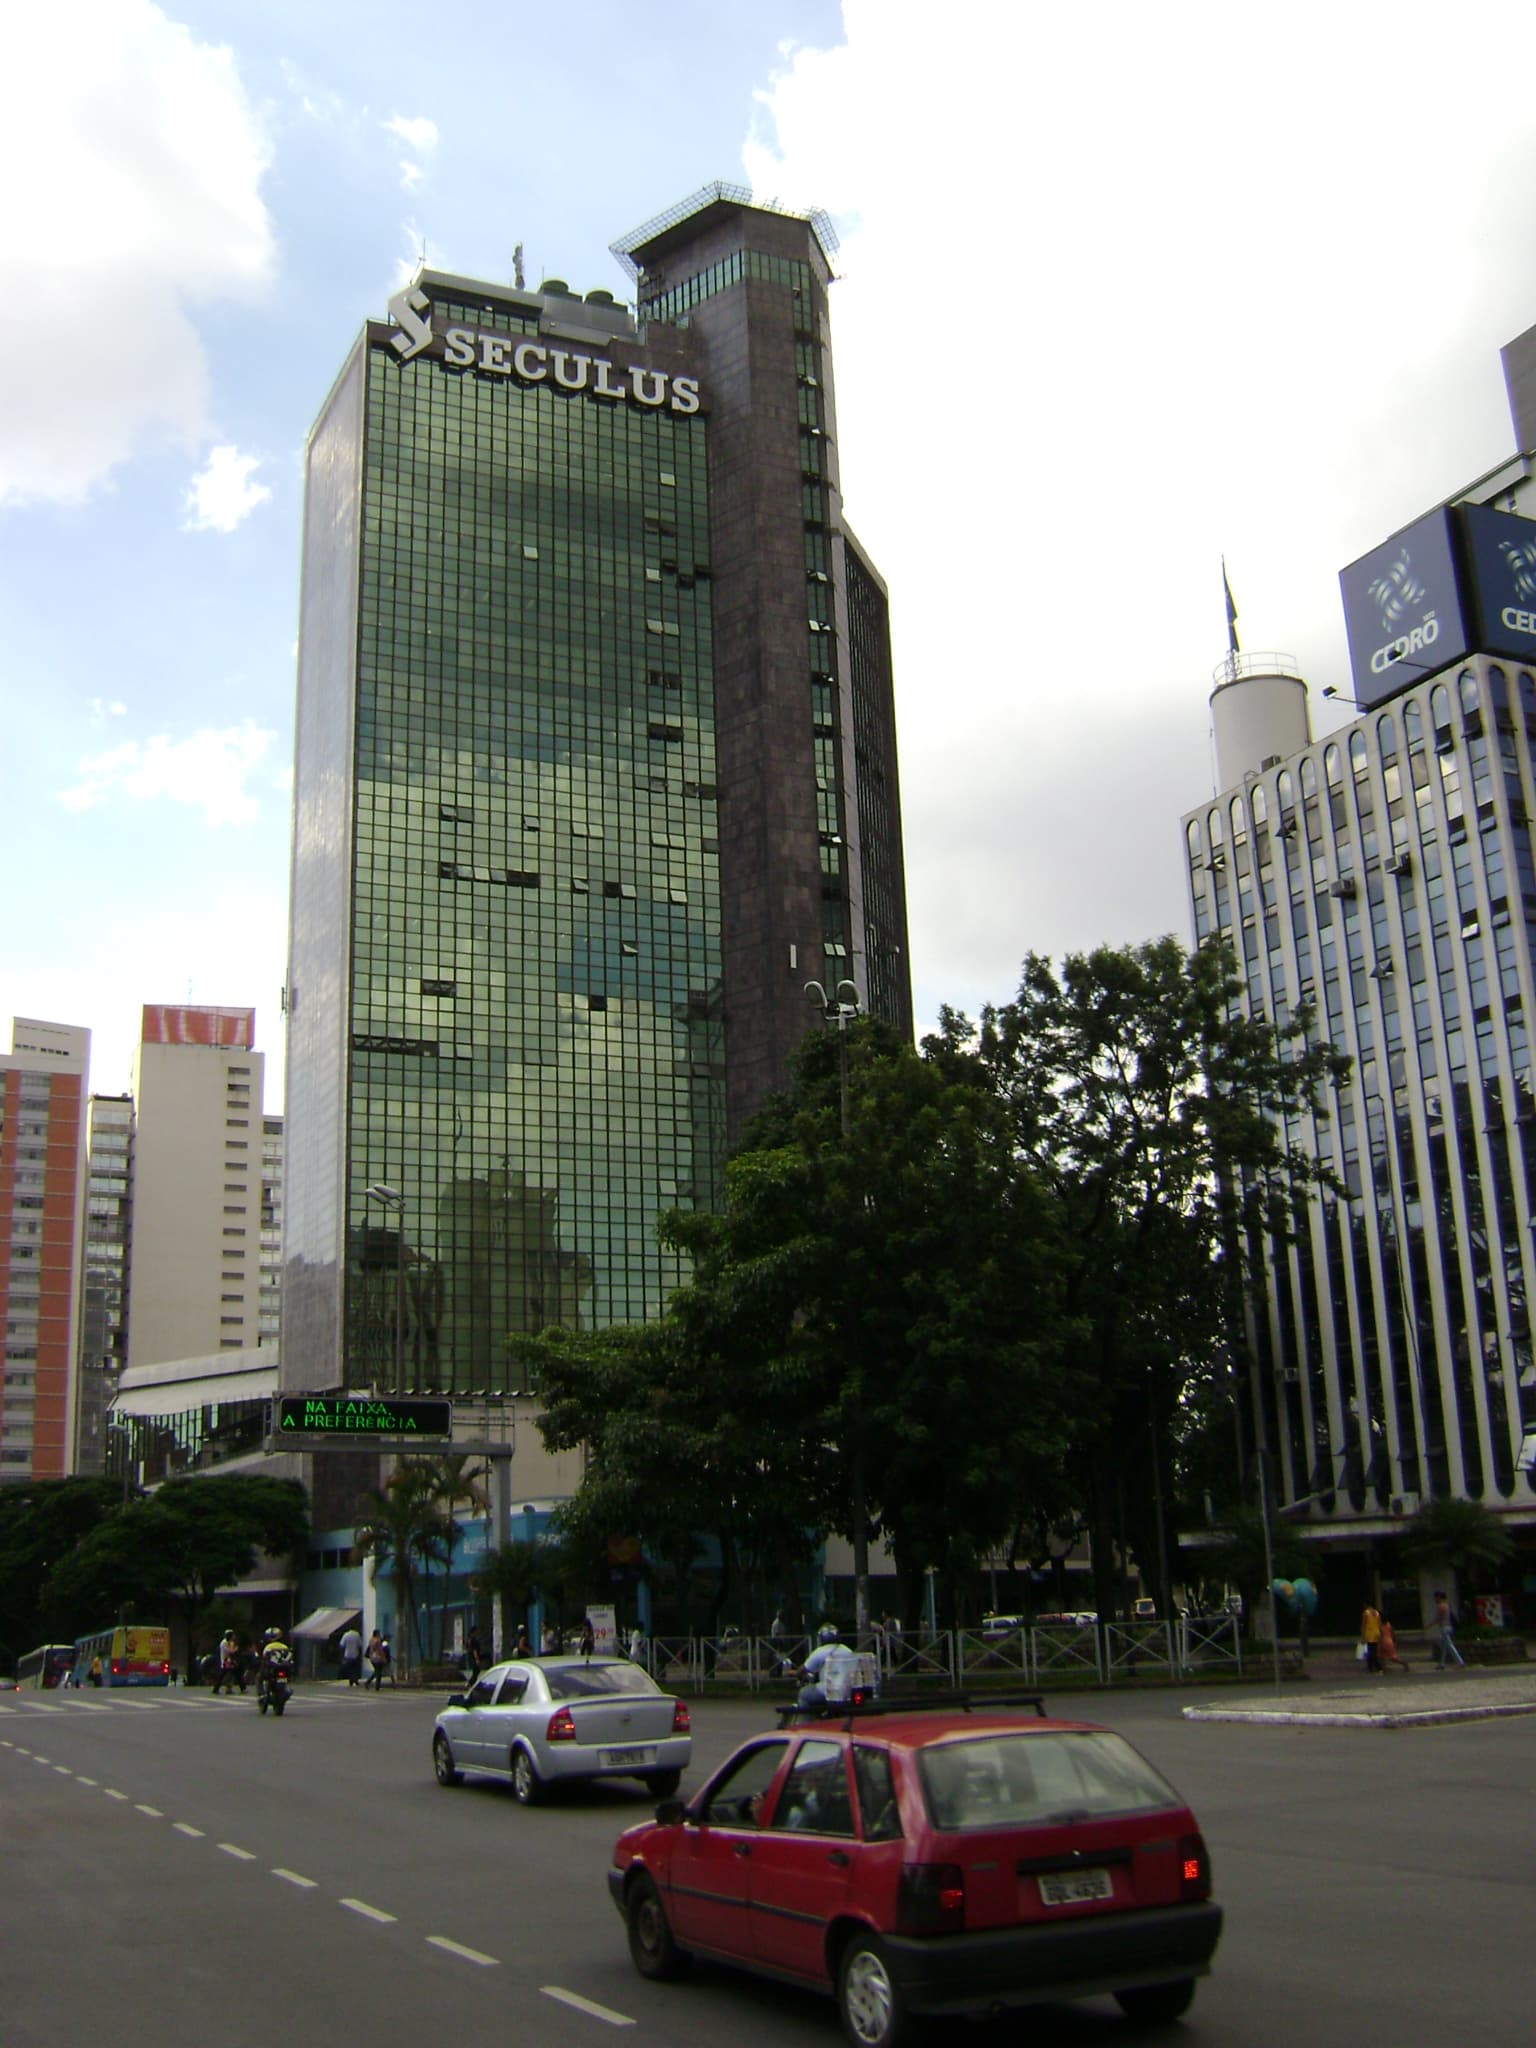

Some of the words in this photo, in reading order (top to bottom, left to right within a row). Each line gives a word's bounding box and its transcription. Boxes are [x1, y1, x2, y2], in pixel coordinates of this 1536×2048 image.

[445, 329, 699, 413] SECULUS
[306, 1401, 326, 1413] NA
[283, 1414, 295, 1426] A
